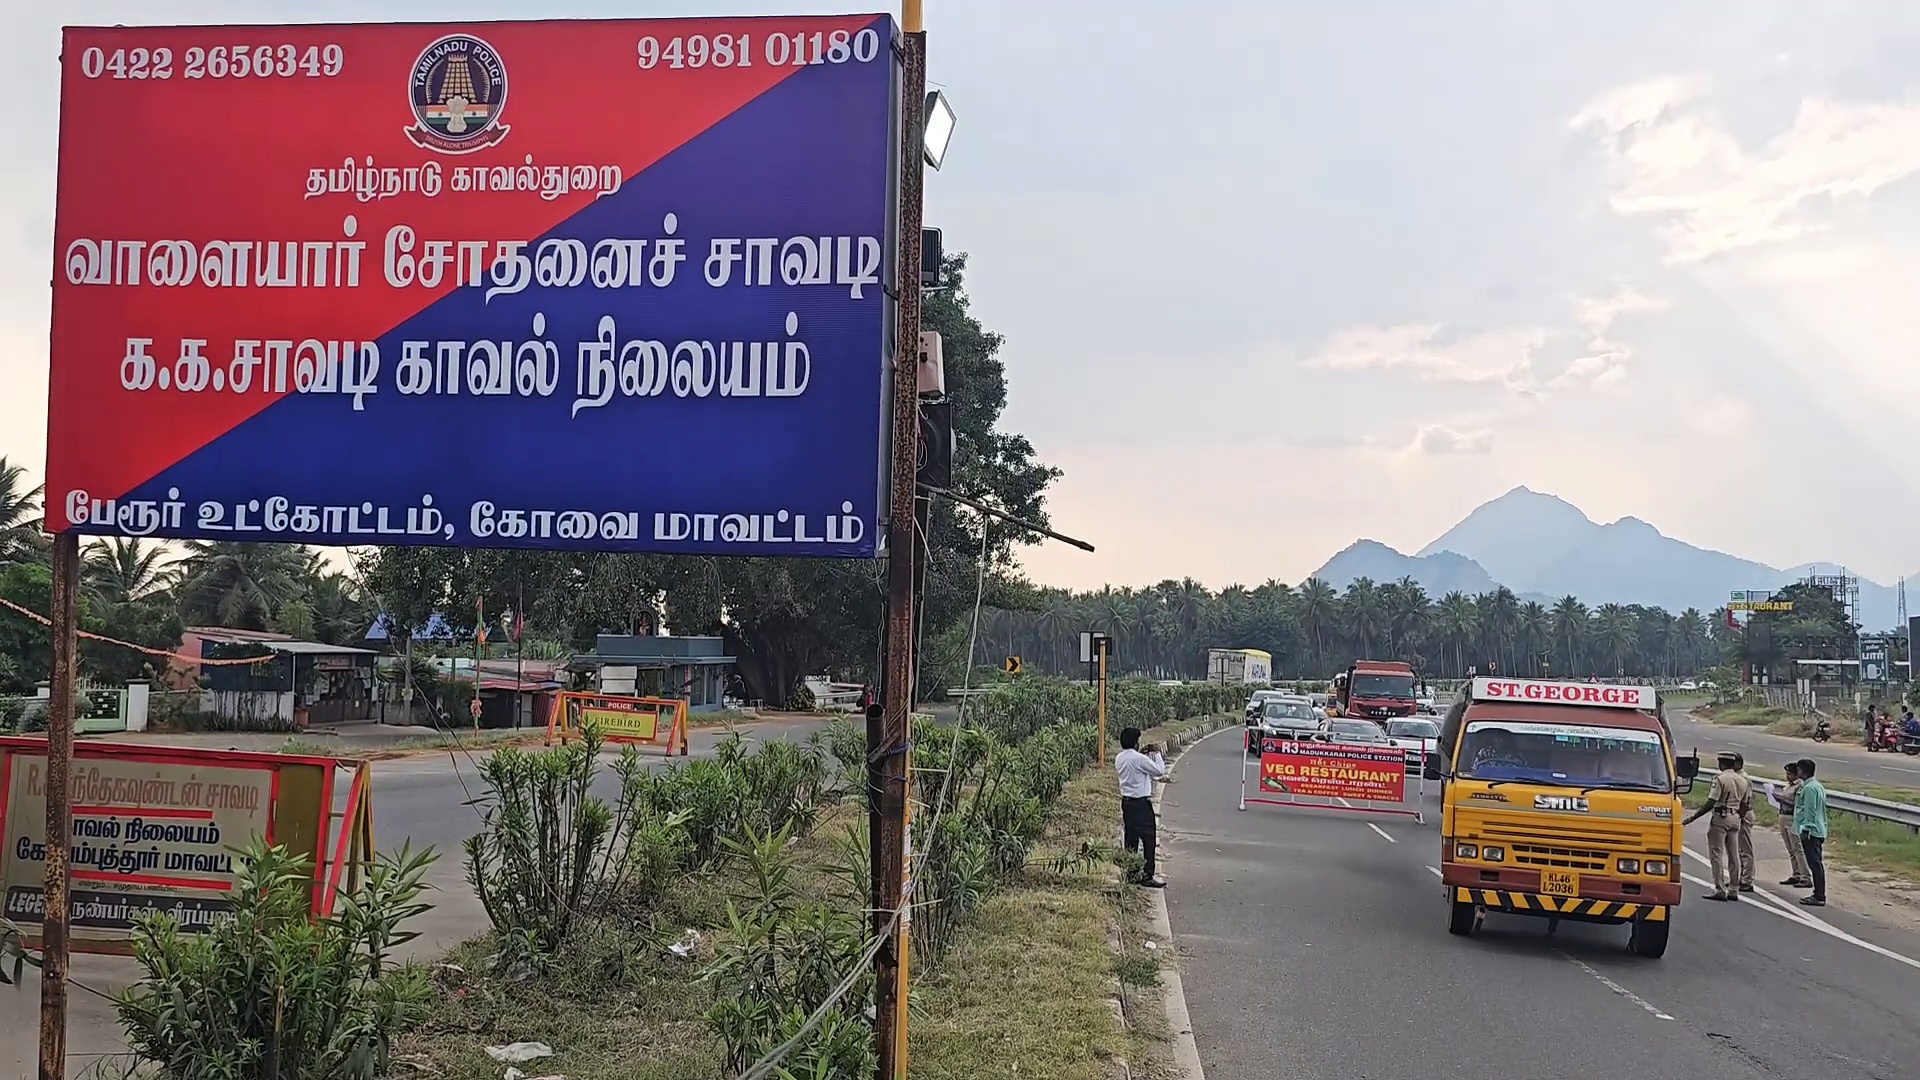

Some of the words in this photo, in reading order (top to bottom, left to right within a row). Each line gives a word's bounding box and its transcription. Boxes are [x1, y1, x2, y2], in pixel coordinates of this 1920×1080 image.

[82, 47, 173, 79] 0422
[184, 44, 344, 79] 2656349
[415, 41, 468, 88] TAMILNADU
[472, 45, 502, 87] POLICE
[637, 33, 752, 69] 94981
[765, 28, 880, 66] 01180
[304, 155, 443, 202] தமிழ்நாடு
[450, 153, 622, 201] காவல்துறை
[65, 214, 367, 288] வாளையார்
[383, 212, 687, 307] சோதனைச்
[703, 235, 881, 300] சாவடி
[120, 337, 380, 411] க.க.சாவடி
[395, 311, 560, 397] காவல்
[571, 311, 811, 419] நிலையம்
[65, 487, 186, 536] பேரூர்
[193, 494, 456, 541] உட்கோட்டம்,
[469, 500, 639, 540] கோவை
[654, 500, 864, 543] மாவட்டம்
[607, 701, 632, 710] POLICE
[1487, 682, 1640, 705] ST.GEORGE
[1281, 741, 1299, 754] R3
[1299, 749, 1346, 758] MADUKKARAI
[1347, 752, 1373, 760] POLICE
[1374, 754, 1403, 762] STATION
[1265, 763, 1295, 775] VEG
[1300, 765, 1400, 783] RESTAURANT
[206, 783, 259, 818] சாவடி
[124, 818, 220, 847] நிலையம்
